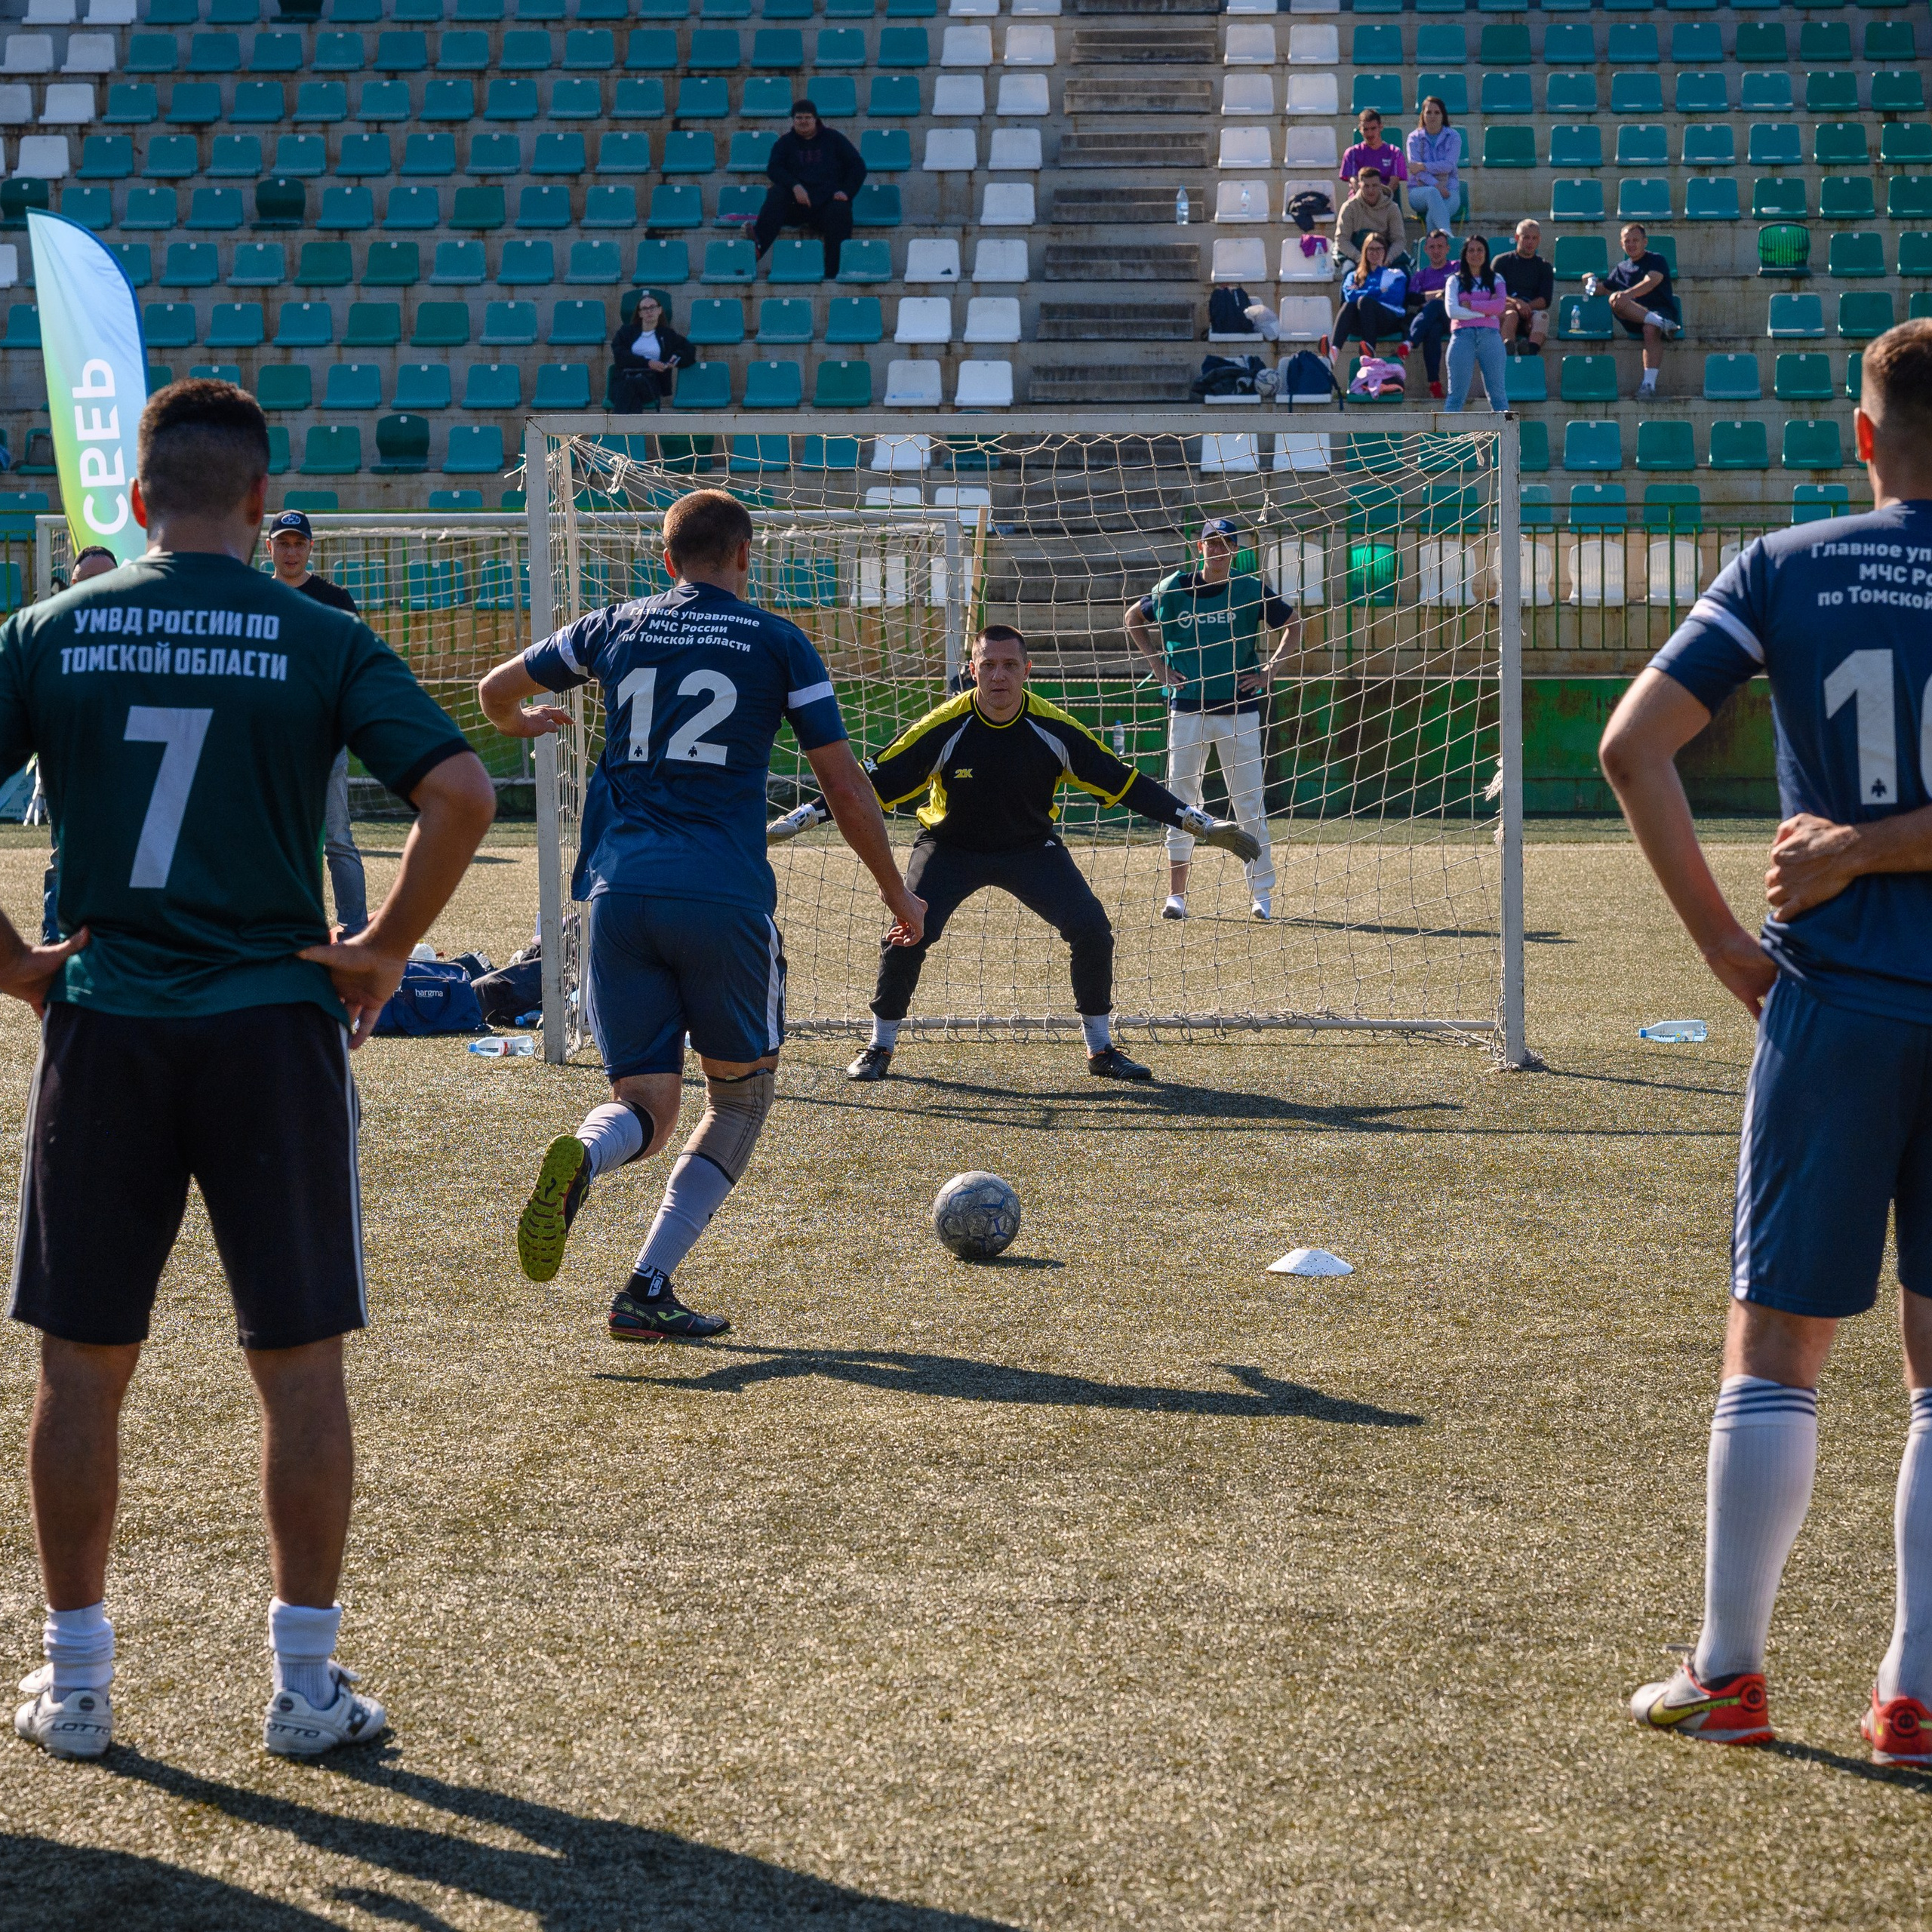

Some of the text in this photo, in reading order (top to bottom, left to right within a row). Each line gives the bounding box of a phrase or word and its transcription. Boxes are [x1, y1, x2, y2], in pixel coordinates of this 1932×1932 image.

[1811, 541, 1903, 559] Главное
[1859, 563, 1908, 583] МЧС
[1817, 586, 1932, 610] по Томской
[74, 607, 280, 640] УМВД РОССИИ ПО
[629, 607, 760, 627] Главное управление
[648, 619, 728, 634] МЧС России
[1196, 611, 1237, 624] СБЕР
[622, 632, 752, 653] по Томской области
[60, 641, 288, 681] ТОМСКОЙ ОБЛАСТИ
[617, 667, 737, 766] 12
[1823, 648, 1932, 805] 1
[954, 768, 974, 778] 2K
[123, 705, 214, 889] 7
[51, 1722, 110, 1735] LOTTO
